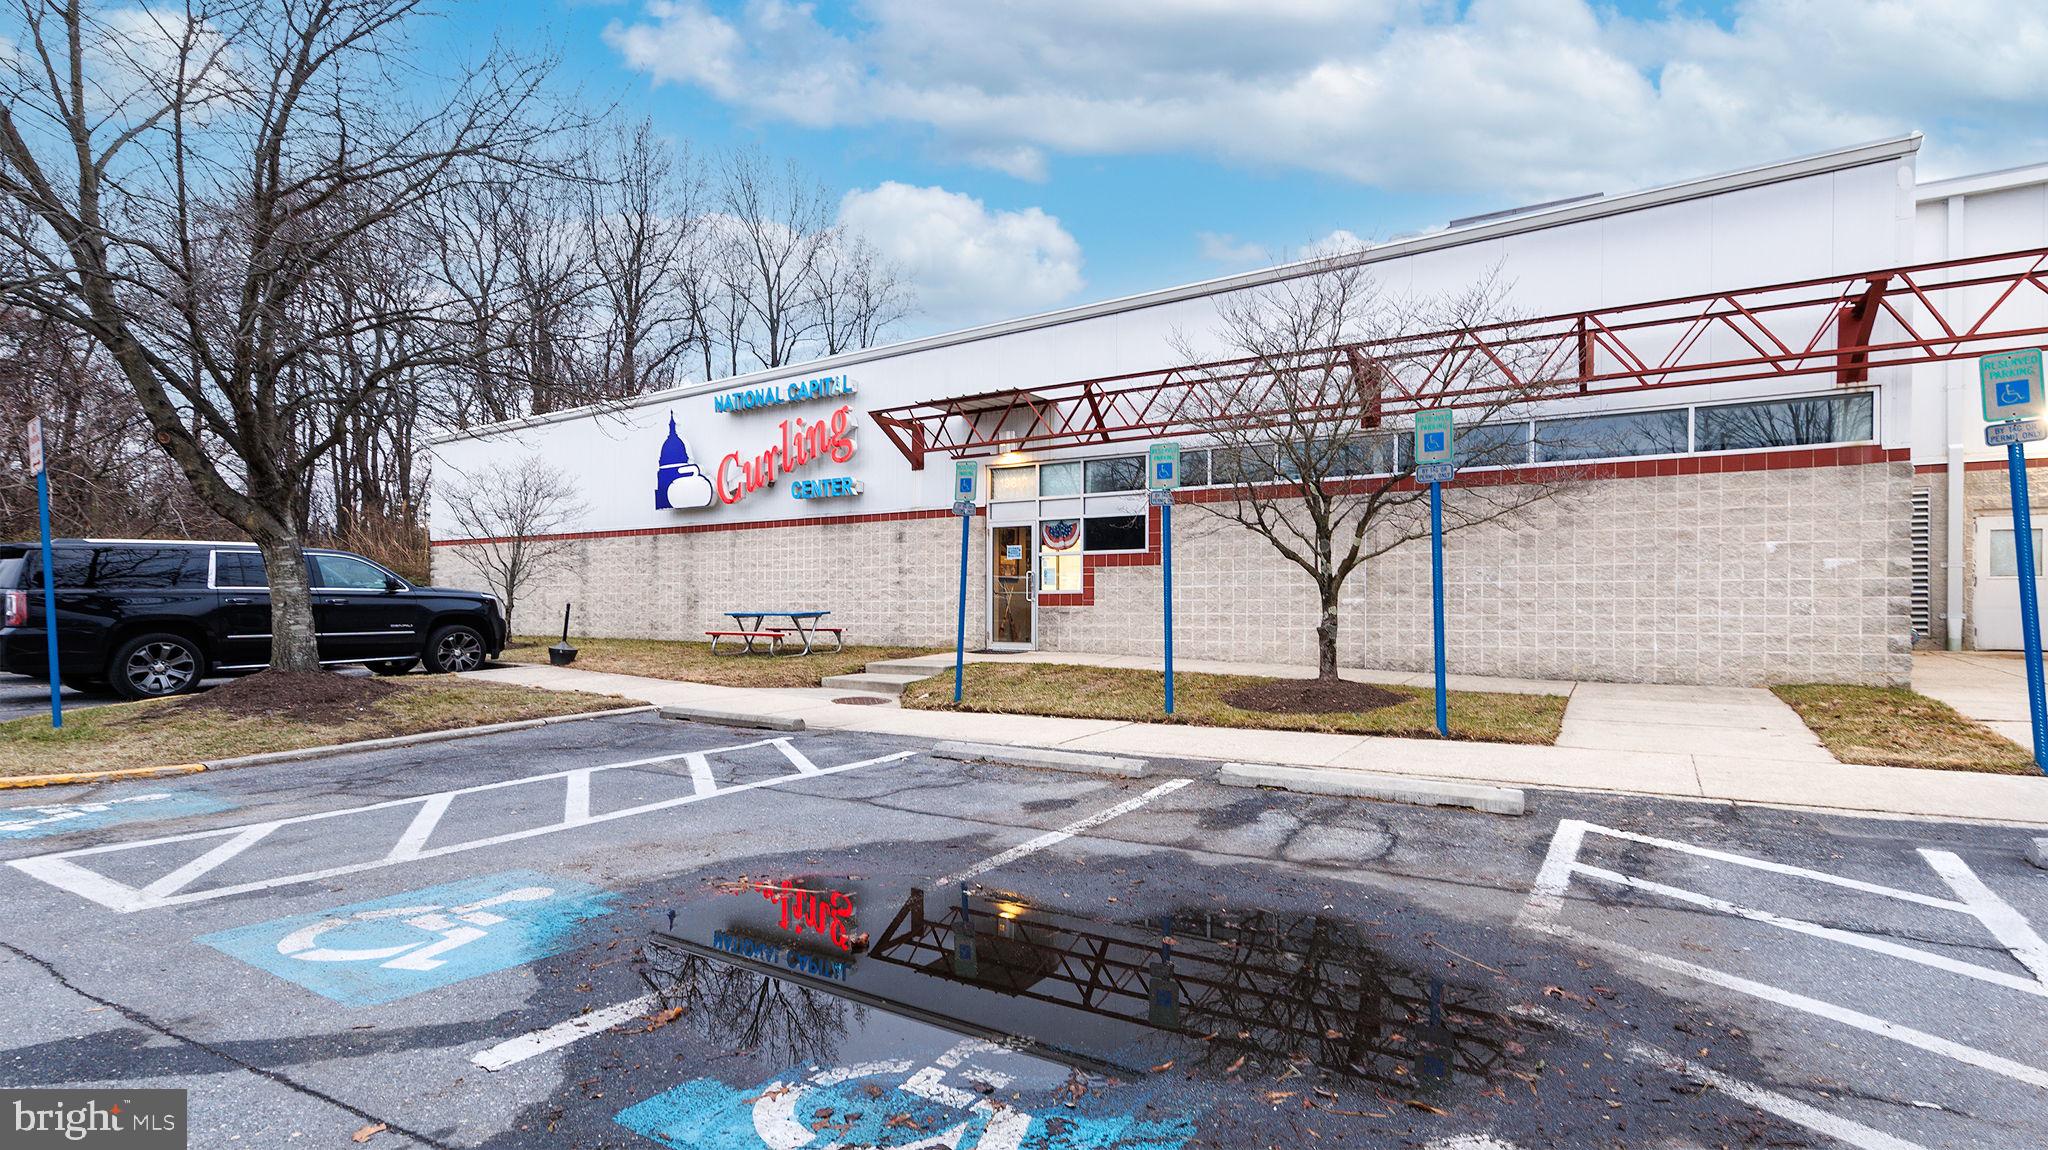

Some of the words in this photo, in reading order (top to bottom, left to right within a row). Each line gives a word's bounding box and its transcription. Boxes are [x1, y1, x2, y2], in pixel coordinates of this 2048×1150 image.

[1989, 367, 2033, 379] PARKING
[714, 386, 784, 413] NATIONAL
[787, 374, 853, 402] CAPITAL
[716, 405, 856, 505] Curling
[791, 476, 857, 500] CENTER
